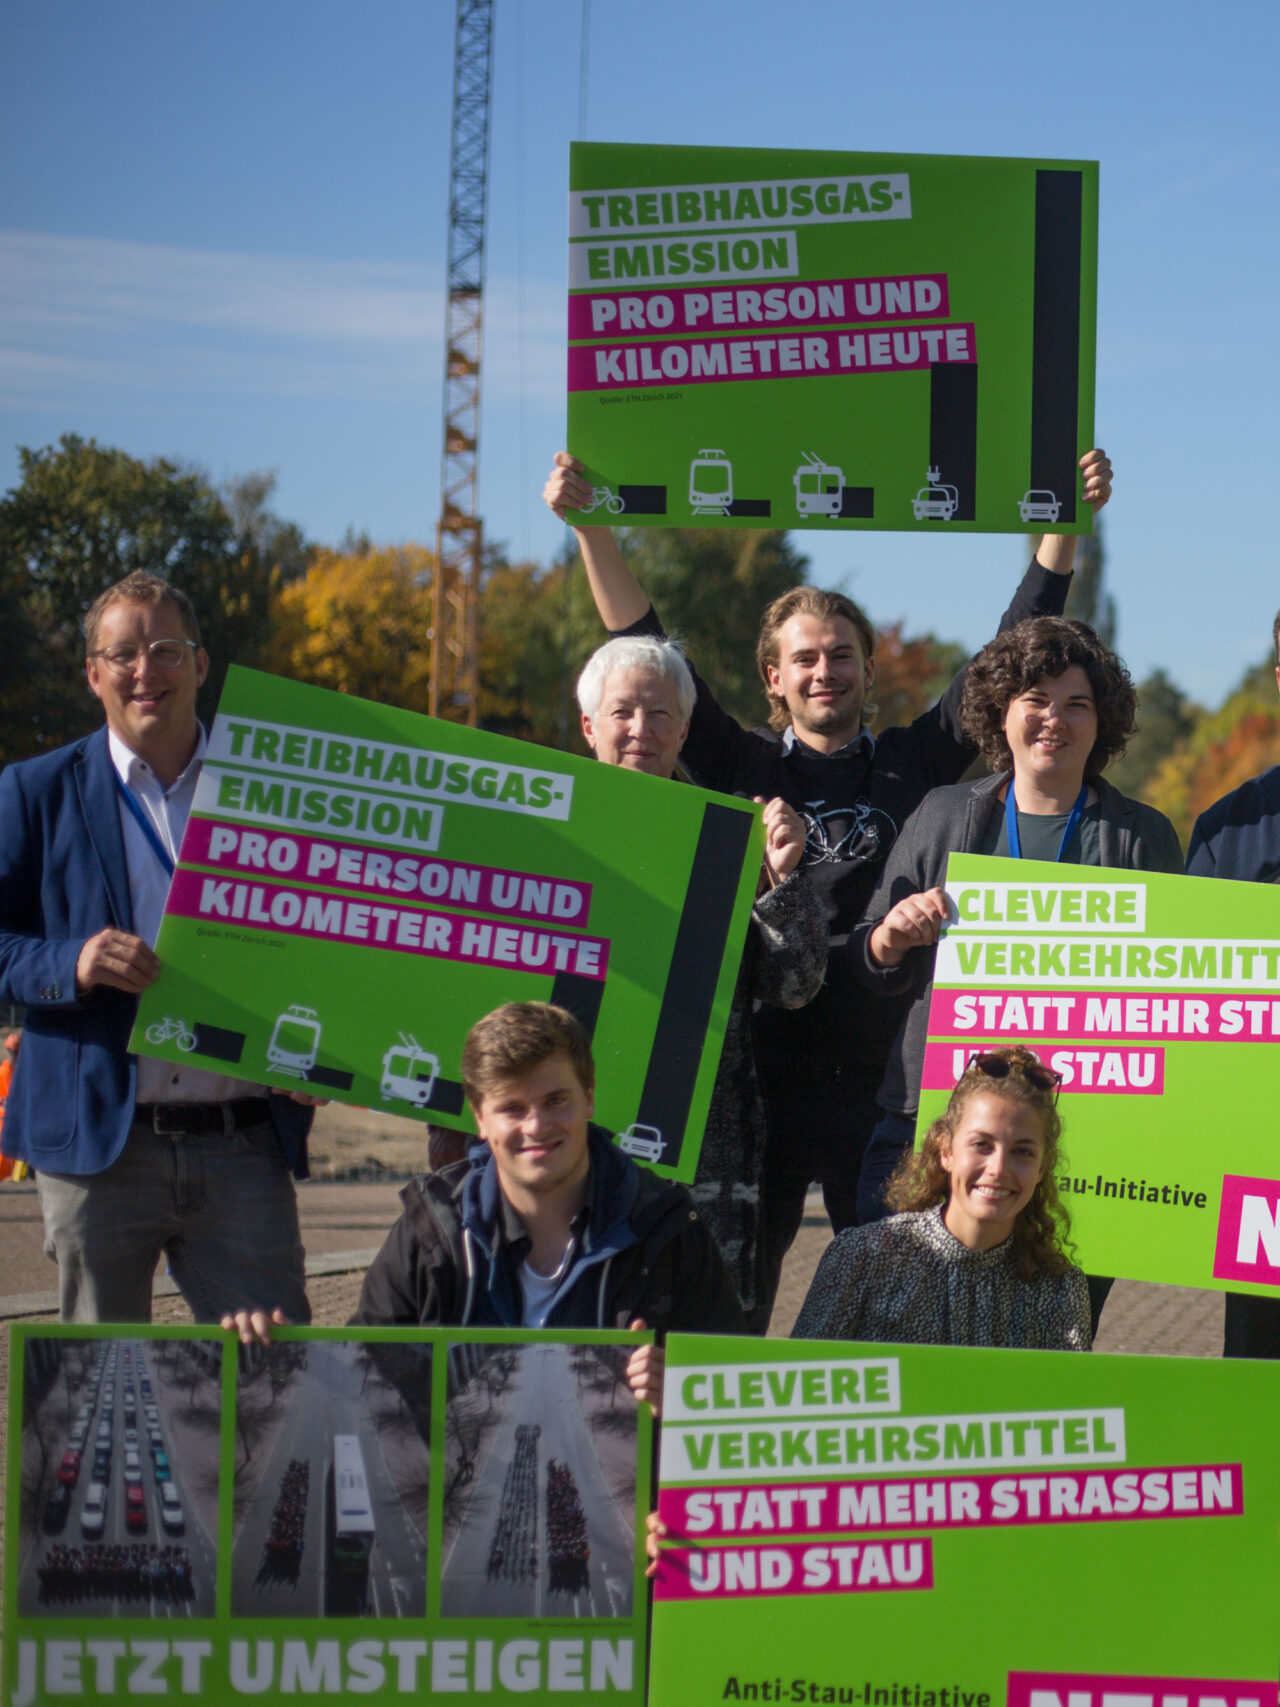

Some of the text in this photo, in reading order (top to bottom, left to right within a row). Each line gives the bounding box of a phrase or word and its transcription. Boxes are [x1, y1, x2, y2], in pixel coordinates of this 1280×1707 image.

[582, 180, 903, 229] TREIBHAUSGAS-
[588, 238, 790, 280] EMISSION
[591, 280, 942, 332] PRO PERSON UND
[595, 329, 970, 383] KILOMETER HEUTE
[227, 722, 564, 808] TREIBHAUSGAS-
[217, 776, 433, 843] EMISSION
[207, 828, 583, 918] PRO PERSON UND
[200, 879, 600, 975] KILOMETER HEUTE
[958, 889, 1136, 923] CLEVERE
[952, 996, 1075, 1031] STATT
[1084, 999, 1209, 1034] MEHR
[1051, 1051, 1155, 1087] STAU
[681, 1365, 890, 1410] CLEVERE
[683, 1416, 1116, 1470] VERKEHRSMITTEL
[685, 1469, 1233, 1533] STATT MEHR STRASSEN
[689, 1543, 924, 1592] UND STAU
[11, 1638, 634, 1707] JETZT UMSTEIGEN
[723, 1677, 991, 1707] Anti-Stau-Initiative
